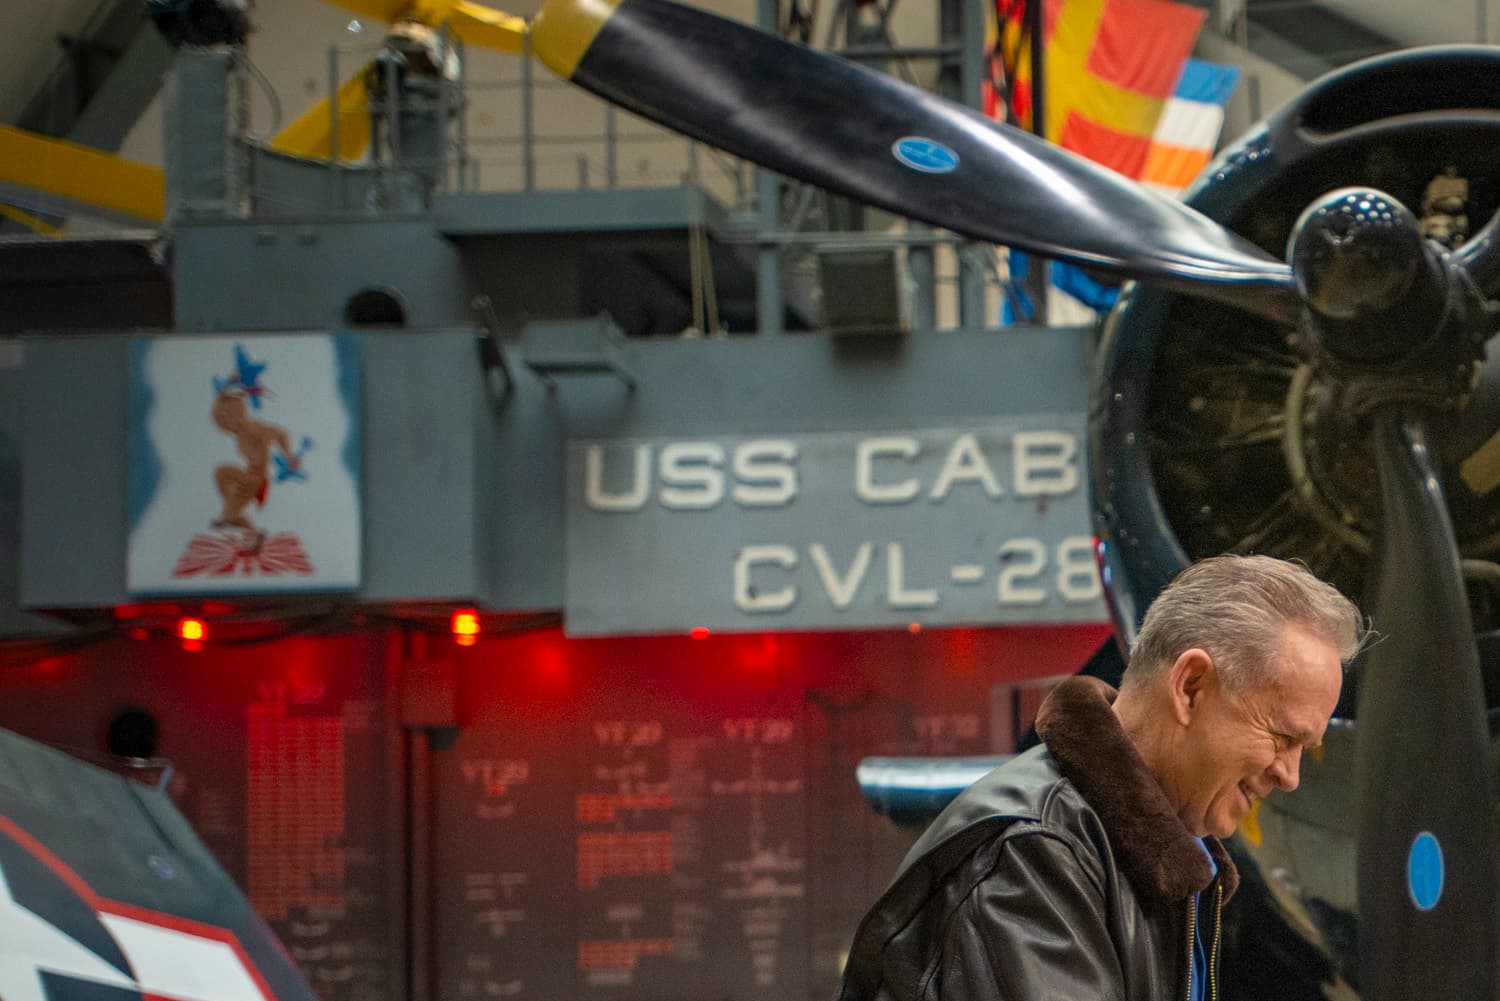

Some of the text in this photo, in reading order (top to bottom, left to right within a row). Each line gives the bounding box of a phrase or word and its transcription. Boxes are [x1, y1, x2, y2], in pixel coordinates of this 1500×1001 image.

[586, 431, 1079, 510] USS CAB
[734, 536, 1101, 609] CVL-28
